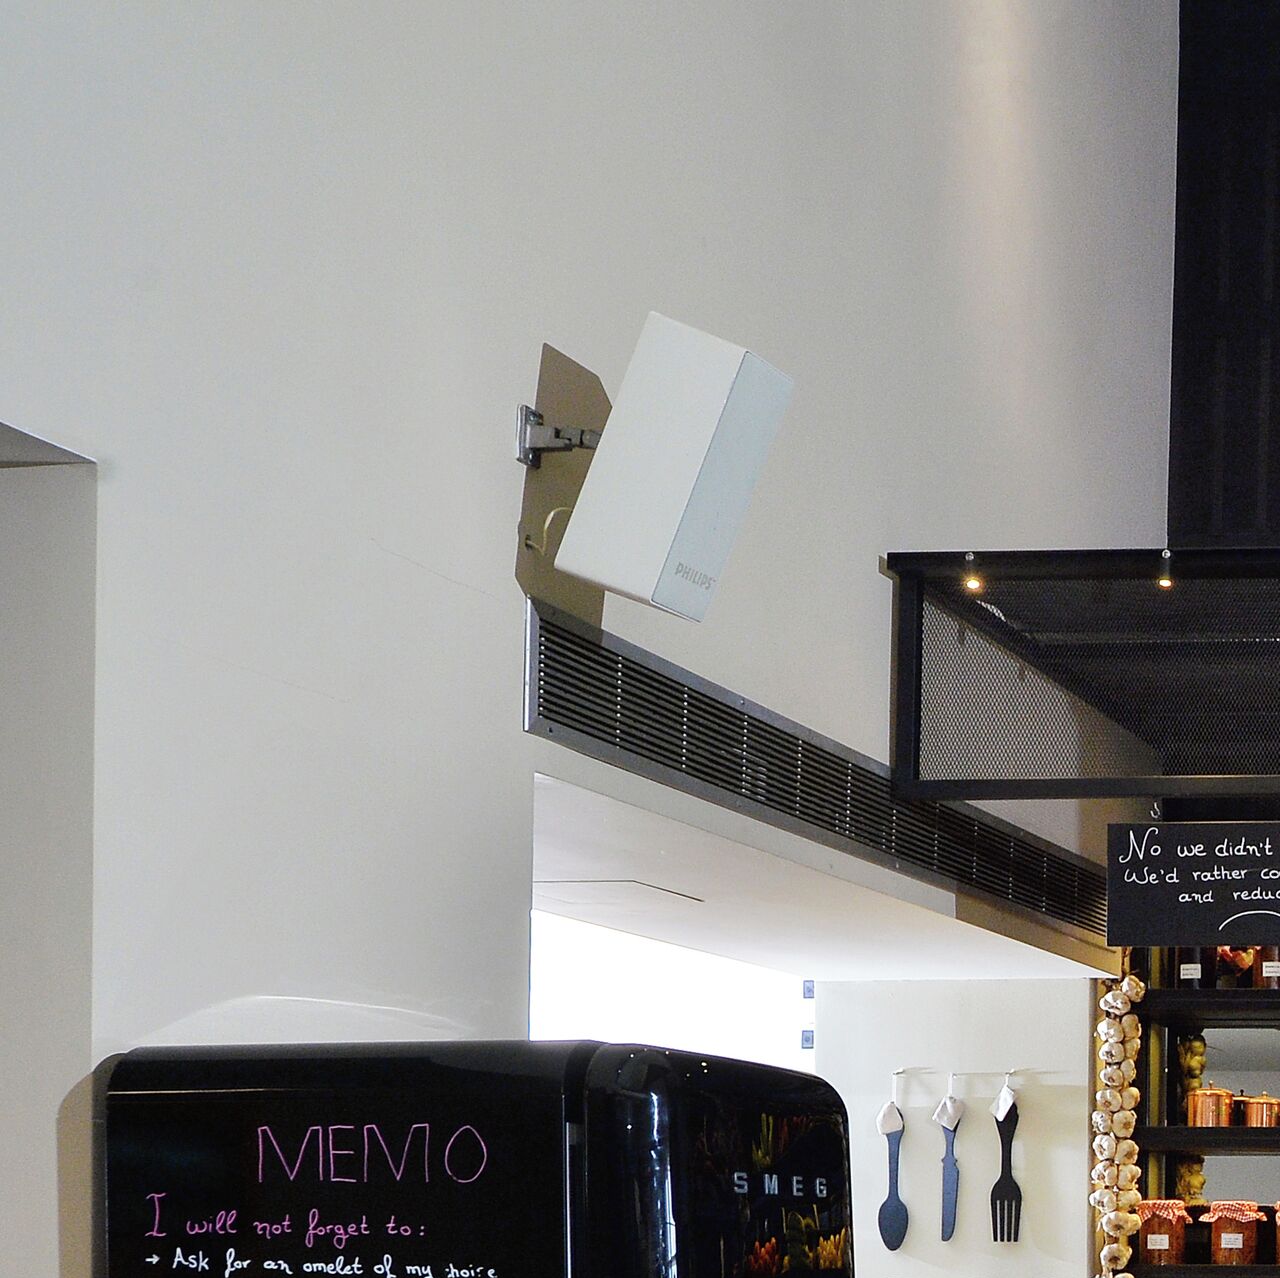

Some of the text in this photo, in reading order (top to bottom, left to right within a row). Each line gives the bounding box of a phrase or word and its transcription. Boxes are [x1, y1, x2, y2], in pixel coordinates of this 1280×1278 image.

[674, 561, 715, 590] PHILIPS
[1118, 827, 1162, 864] No
[1177, 843, 1207, 858] we
[1215, 836, 1273, 857] didn't
[1123, 866, 1180, 884] We'd
[1192, 864, 1247, 882] rather
[1178, 890, 1214, 904] and
[257, 1123, 487, 1183] MEMO
[733, 1171, 828, 1198] SMEG
[145, 1193, 426, 1249] I will not forget to:
[172, 1247, 210, 1272] Ask
[224, 1248, 252, 1278] for
[263, 1260, 293, 1275] an
[303, 1256, 364, 1275] omelet
